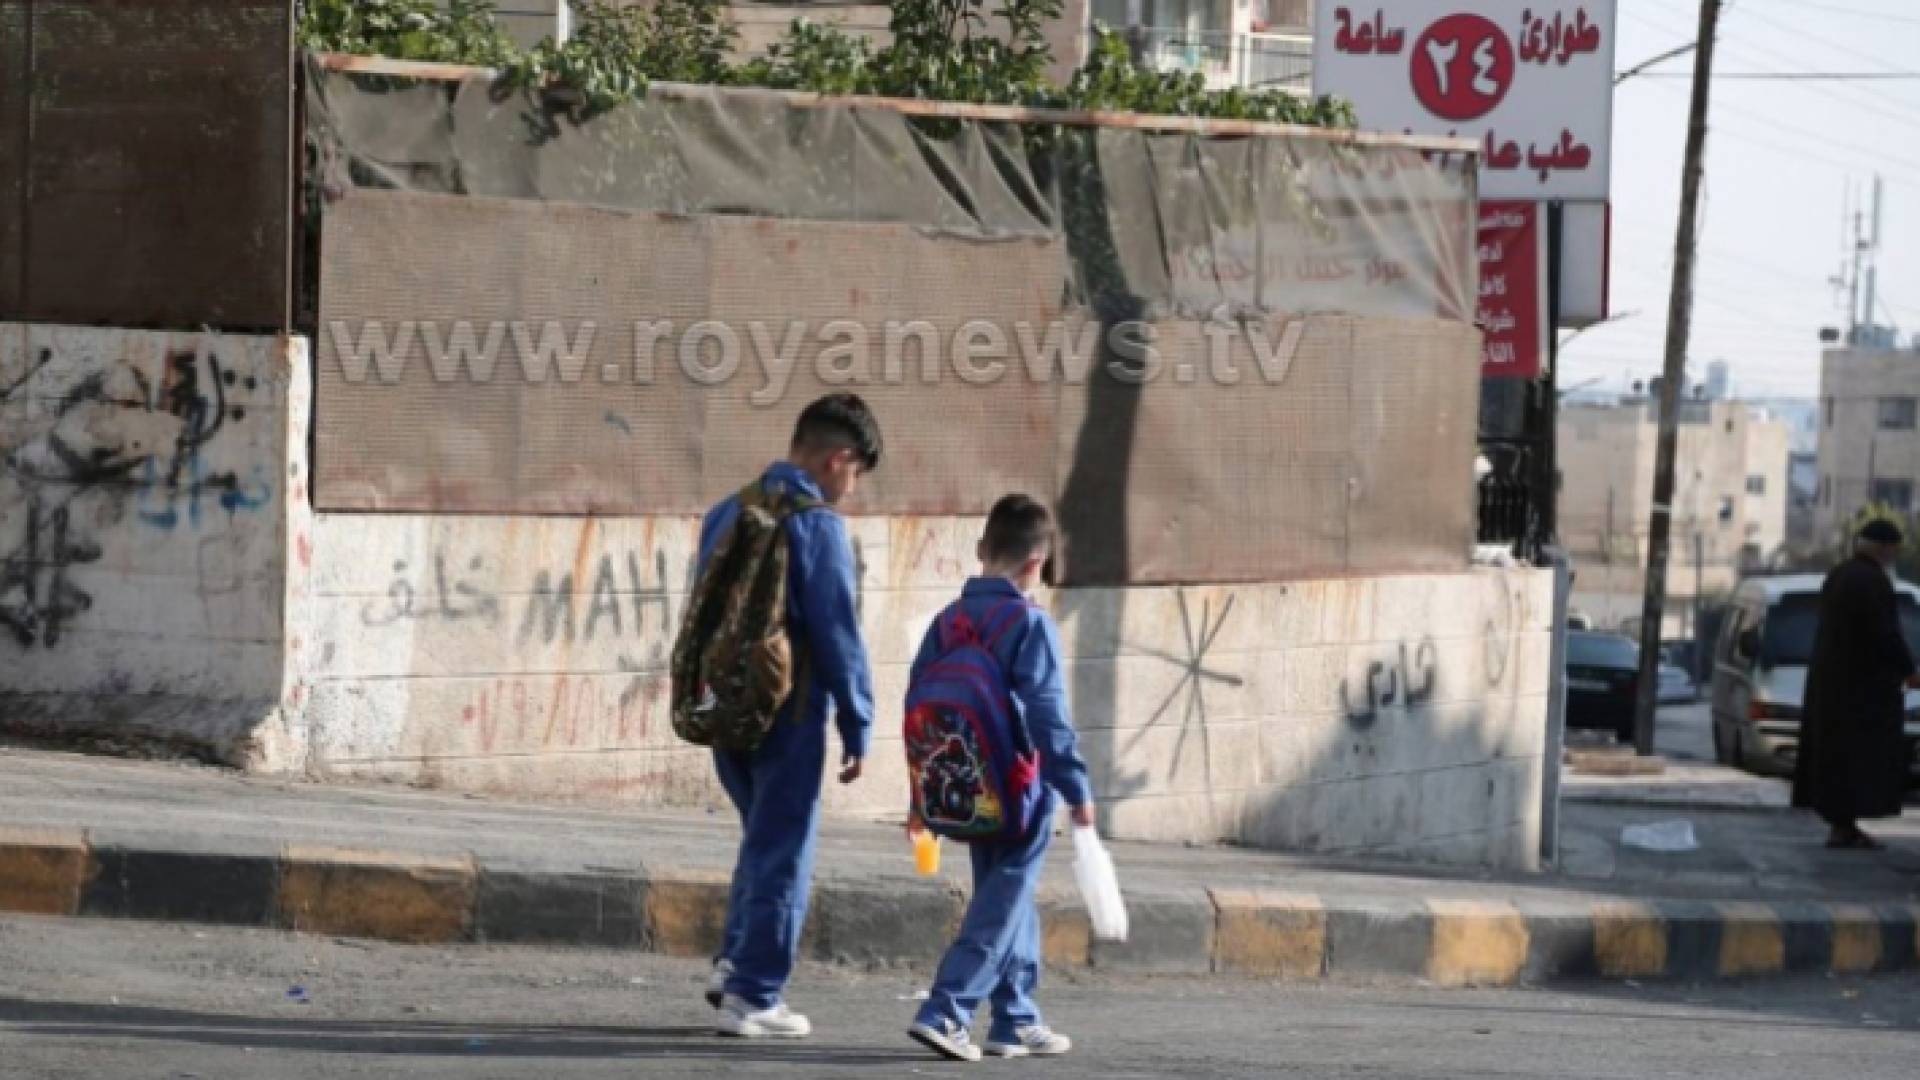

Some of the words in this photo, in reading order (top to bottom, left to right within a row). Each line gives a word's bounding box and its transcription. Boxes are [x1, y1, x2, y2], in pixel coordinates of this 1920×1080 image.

[1334, 7, 1406, 54] ساعة
[1519, 7, 1601, 65] طوارئ
[1425, 37, 1502, 96] ٢٤
[1527, 128, 1592, 183] طب
